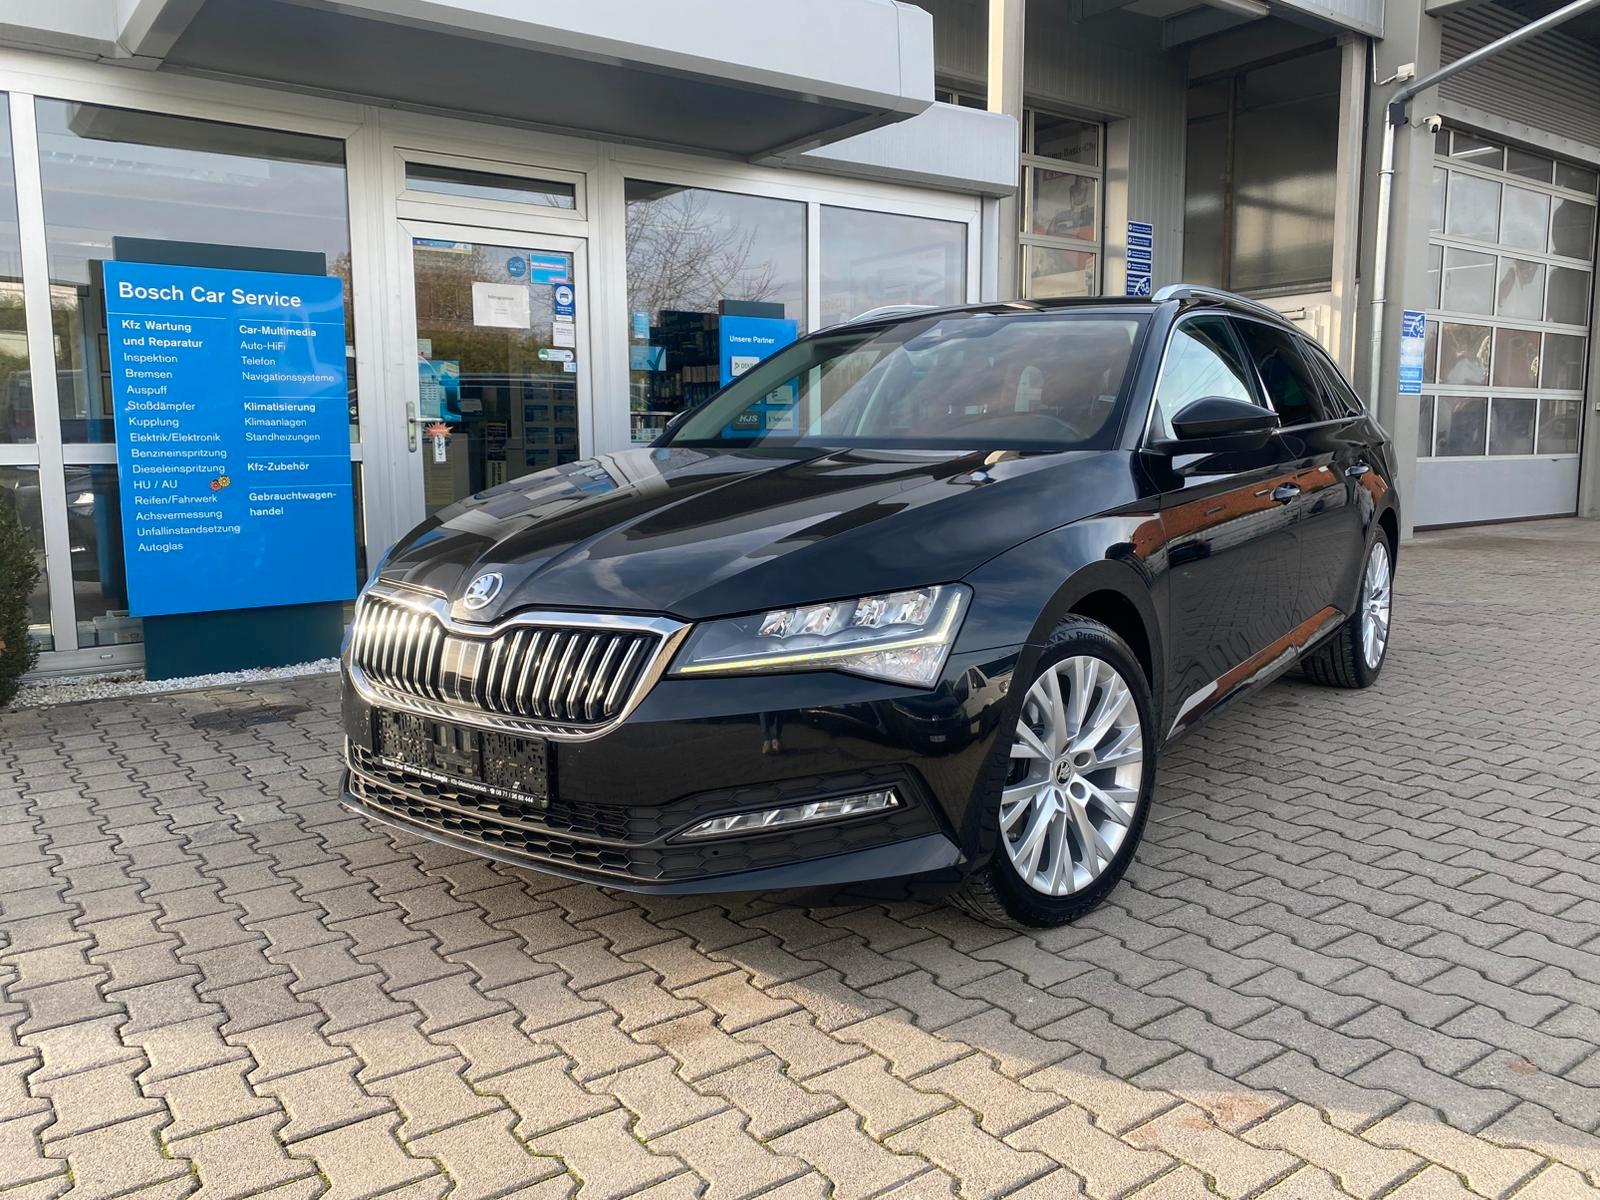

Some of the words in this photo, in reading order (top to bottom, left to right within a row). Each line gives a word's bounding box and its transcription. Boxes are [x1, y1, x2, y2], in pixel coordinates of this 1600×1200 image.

[119, 282, 184, 300] Bosch
[191, 286, 225, 304] Car
[232, 288, 302, 308] Service
[122, 320, 141, 330] Kfz
[145, 320, 192, 333] Wartung
[239, 325, 316, 337] Car-Multimedia
[123, 336, 144, 346] und
[149, 337, 203, 349] Reparatur
[729, 335, 751, 343] Unsere
[753, 336, 775, 344] Partner
[240, 341, 286, 351] Auto-HiFi
[124, 353, 178, 364] Inspektion
[241, 356, 276, 366] Telefon
[125, 369, 172, 379] Bremsen
[242, 372, 334, 384] Navigationssysteme
[127, 385, 167, 396] Auspuff
[127, 401, 195, 412] Stoßdämpfer
[244, 402, 316, 413] Klimatisierung
[129, 417, 179, 428] Kupplung
[245, 418, 307, 428] Klimaanlagen
[130, 433, 221, 443] Elektrik/Elektronik
[246, 432, 320, 442] Standheizungen
[132, 449, 227, 459] Benzineinspritzung
[132, 464, 225, 475] Dieseleinspritzung
[248, 462, 309, 472] Kfz-Zubehör
[134, 480, 150, 489] HU
[154, 480, 158, 489] /
[162, 480, 178, 489] AU
[135, 495, 217, 505] Reifen/Fahrwerk
[249, 491, 337, 502] Gebrauchtwagen-
[136, 510, 222, 521] Achsvermessung
[250, 507, 284, 516] handel
[137, 524, 241, 537] Unfallinstandsetzung
[138, 542, 183, 553] Autoglas
